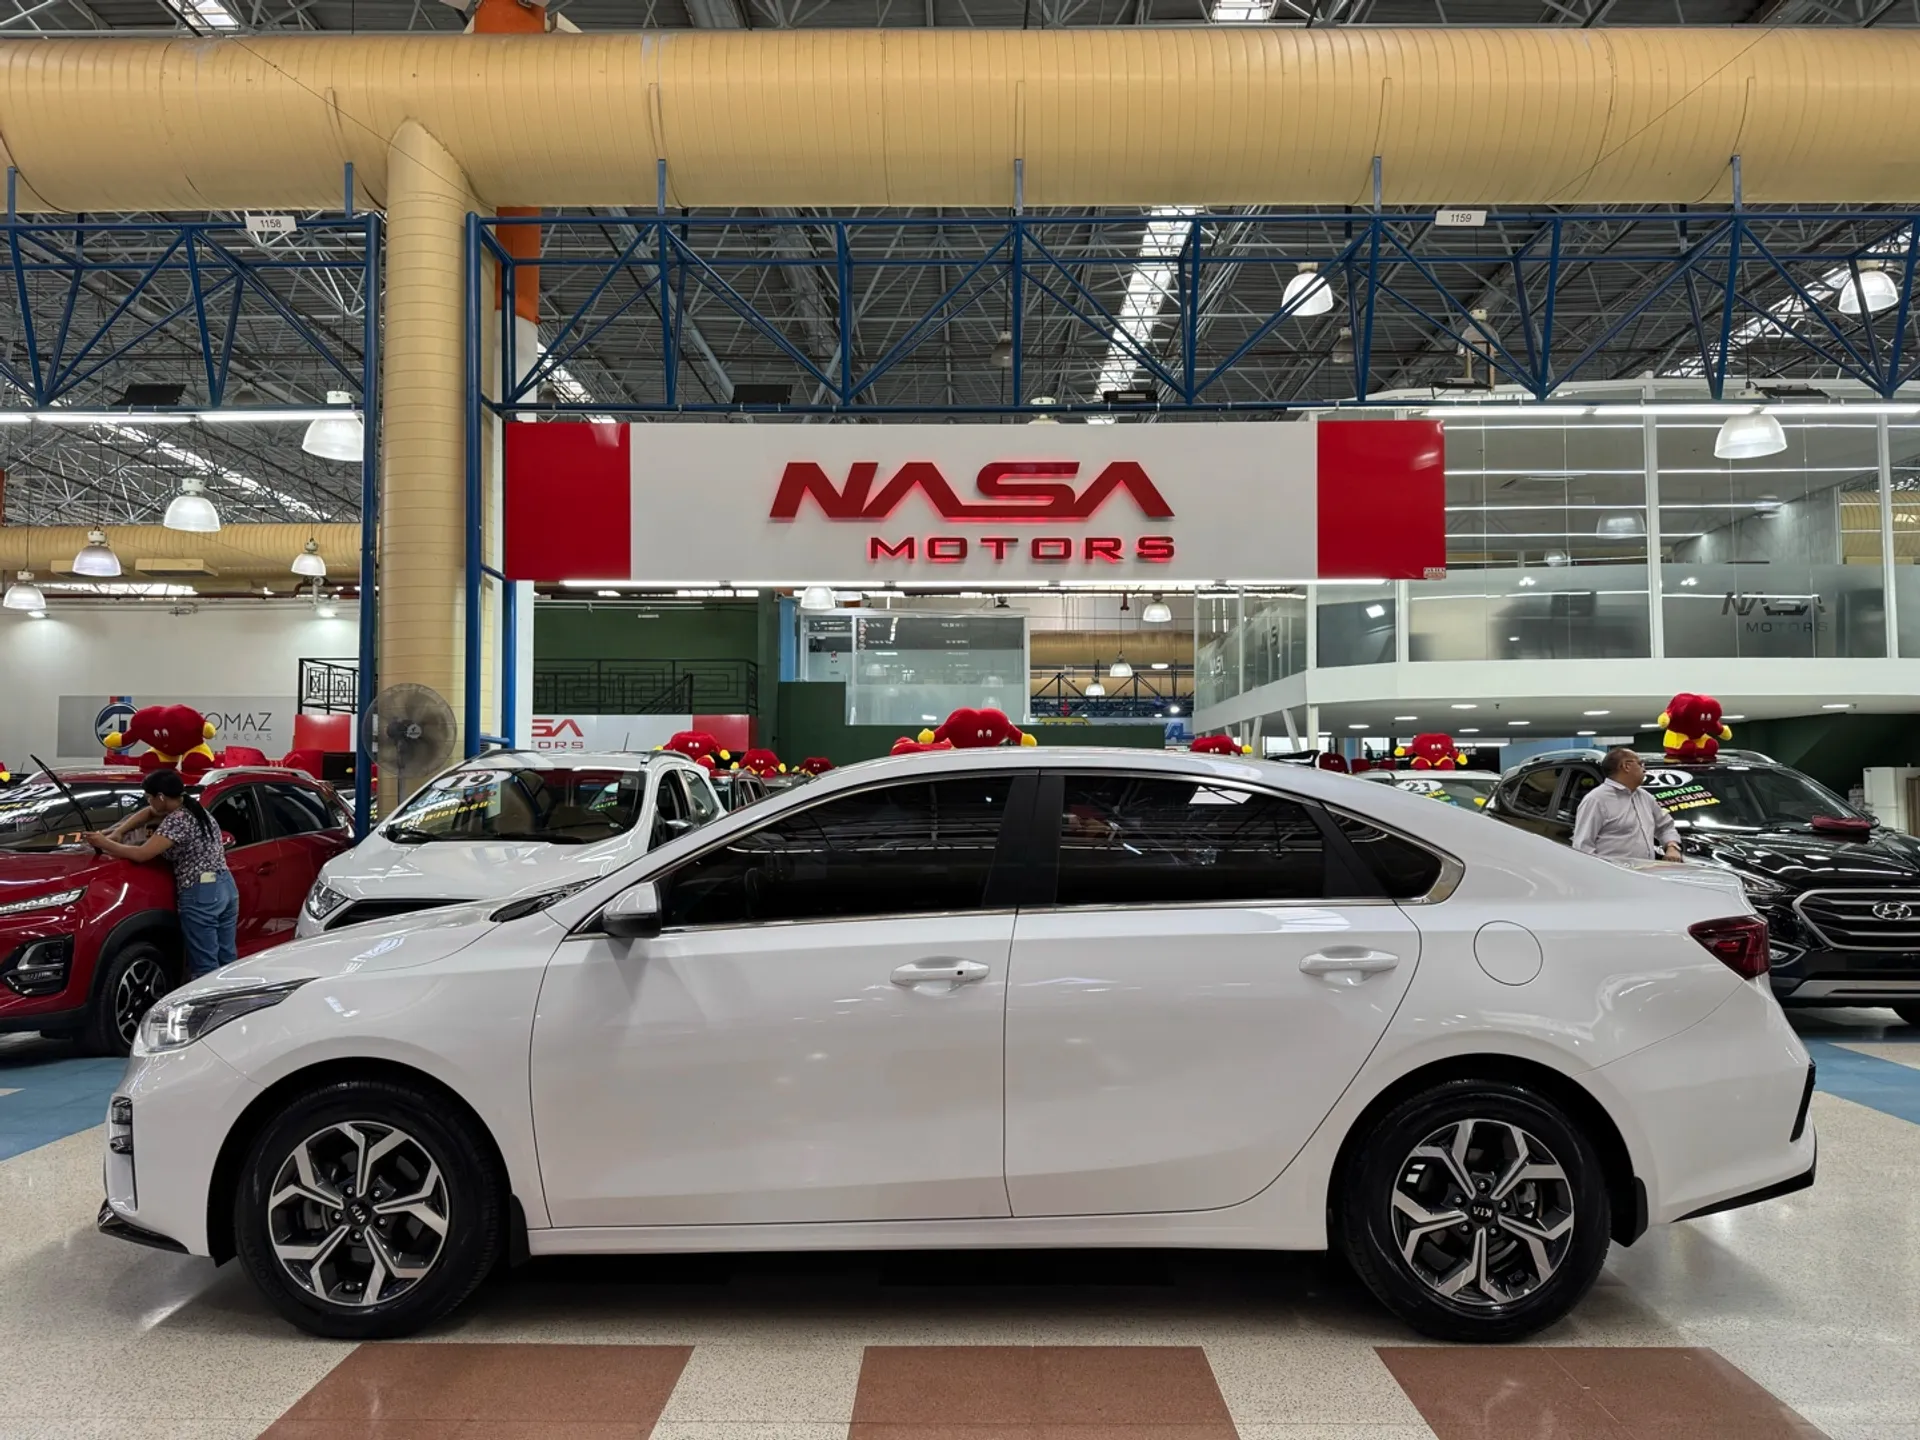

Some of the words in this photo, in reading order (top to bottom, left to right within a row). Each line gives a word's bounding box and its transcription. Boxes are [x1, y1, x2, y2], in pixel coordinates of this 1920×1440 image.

[260, 219, 282, 228] 1158
[1450, 213, 1472, 222] 1159
[769, 461, 1175, 518] NASA
[870, 536, 1175, 561] MOTORS
[1745, 622, 1828, 633] MOTORS
[200, 712, 272, 731] OMAZ
[531, 741, 583, 749] ORS
[1654, 785, 1704, 799] OMATICO
[350, 1203, 367, 1224] KIA
[1472, 1205, 1493, 1218] KIA
